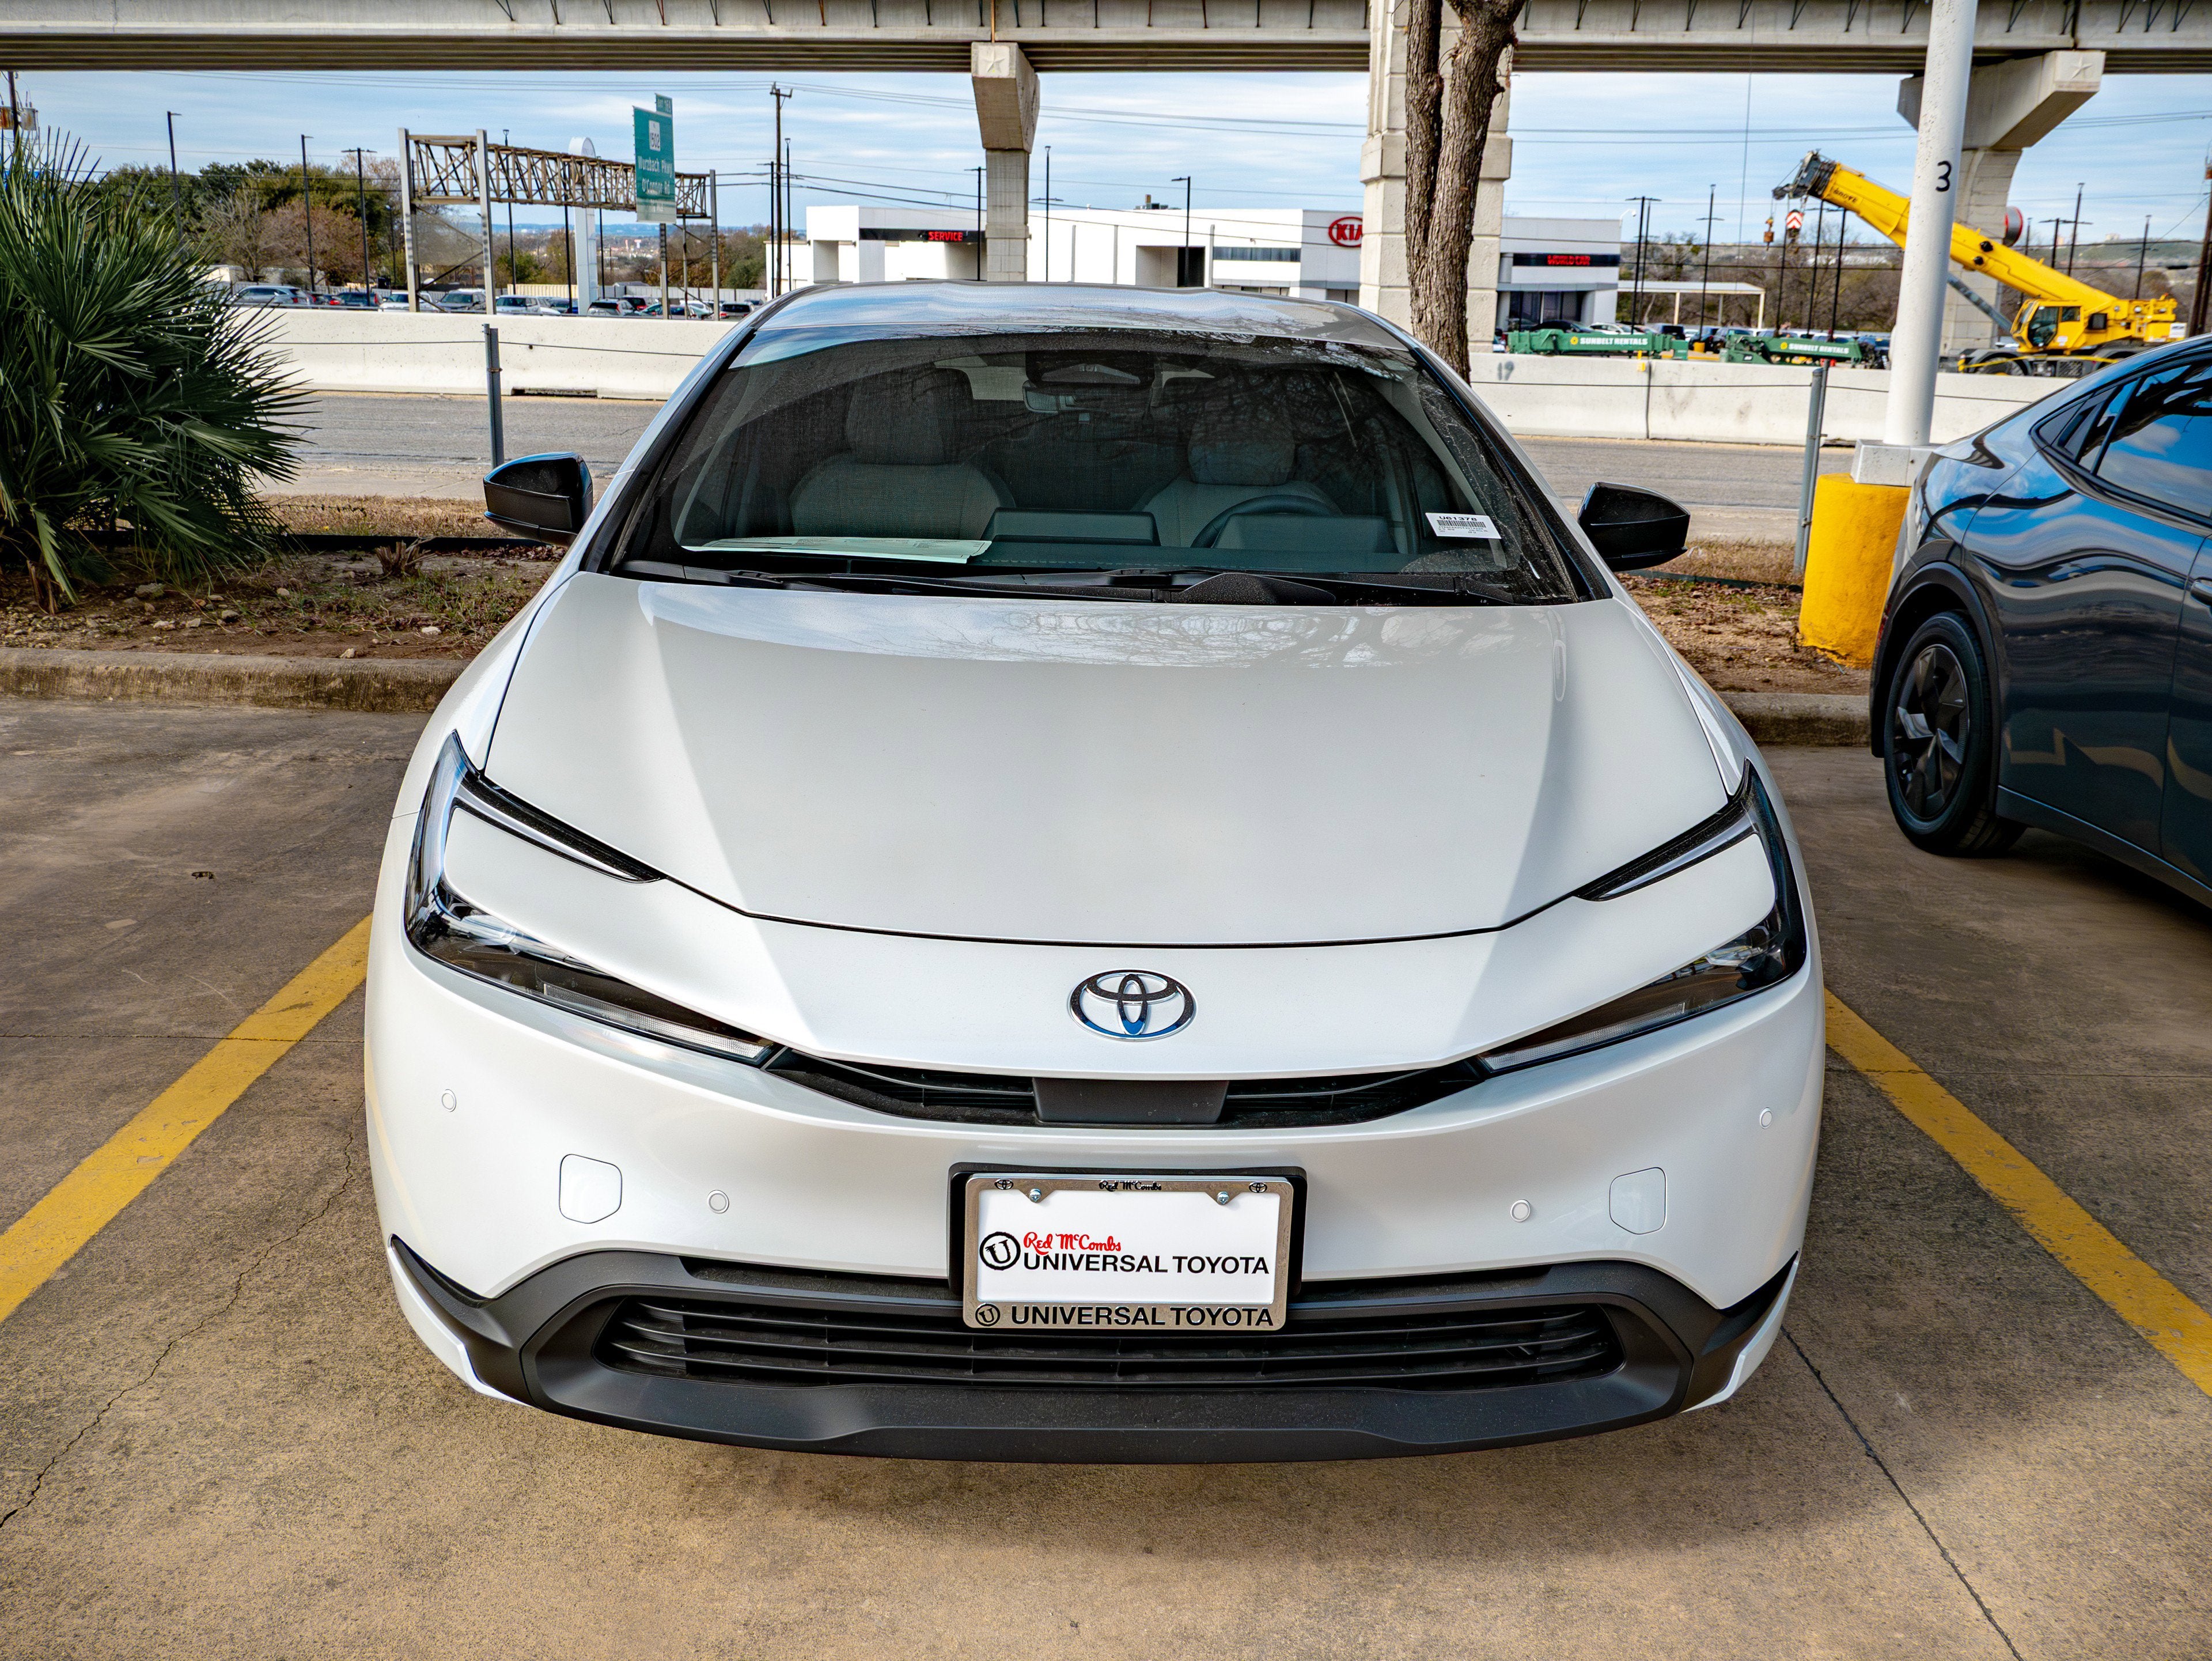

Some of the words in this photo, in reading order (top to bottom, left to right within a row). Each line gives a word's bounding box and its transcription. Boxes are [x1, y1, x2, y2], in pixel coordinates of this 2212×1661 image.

[637, 156, 660, 172] Wurzbach
[1936, 160, 1952, 192] 3
[928, 231, 963, 241] SERVICE
[1580, 337, 1613, 345] SUNBELT
[1614, 338, 1648, 346] RENTALS
[1098, 1179, 1119, 1192] Red
[1119, 1180, 1162, 1191] McCombs
[1023, 1232, 1053, 1255] Red
[1055, 1233, 1122, 1252] McCombs
[1023, 1252, 1168, 1273] UNIVERSAL
[1172, 1255, 1270, 1274] TOYOTA
[1011, 1305, 1166, 1326] UNIVERSAL
[1170, 1306, 1274, 1327] TOYOTA
